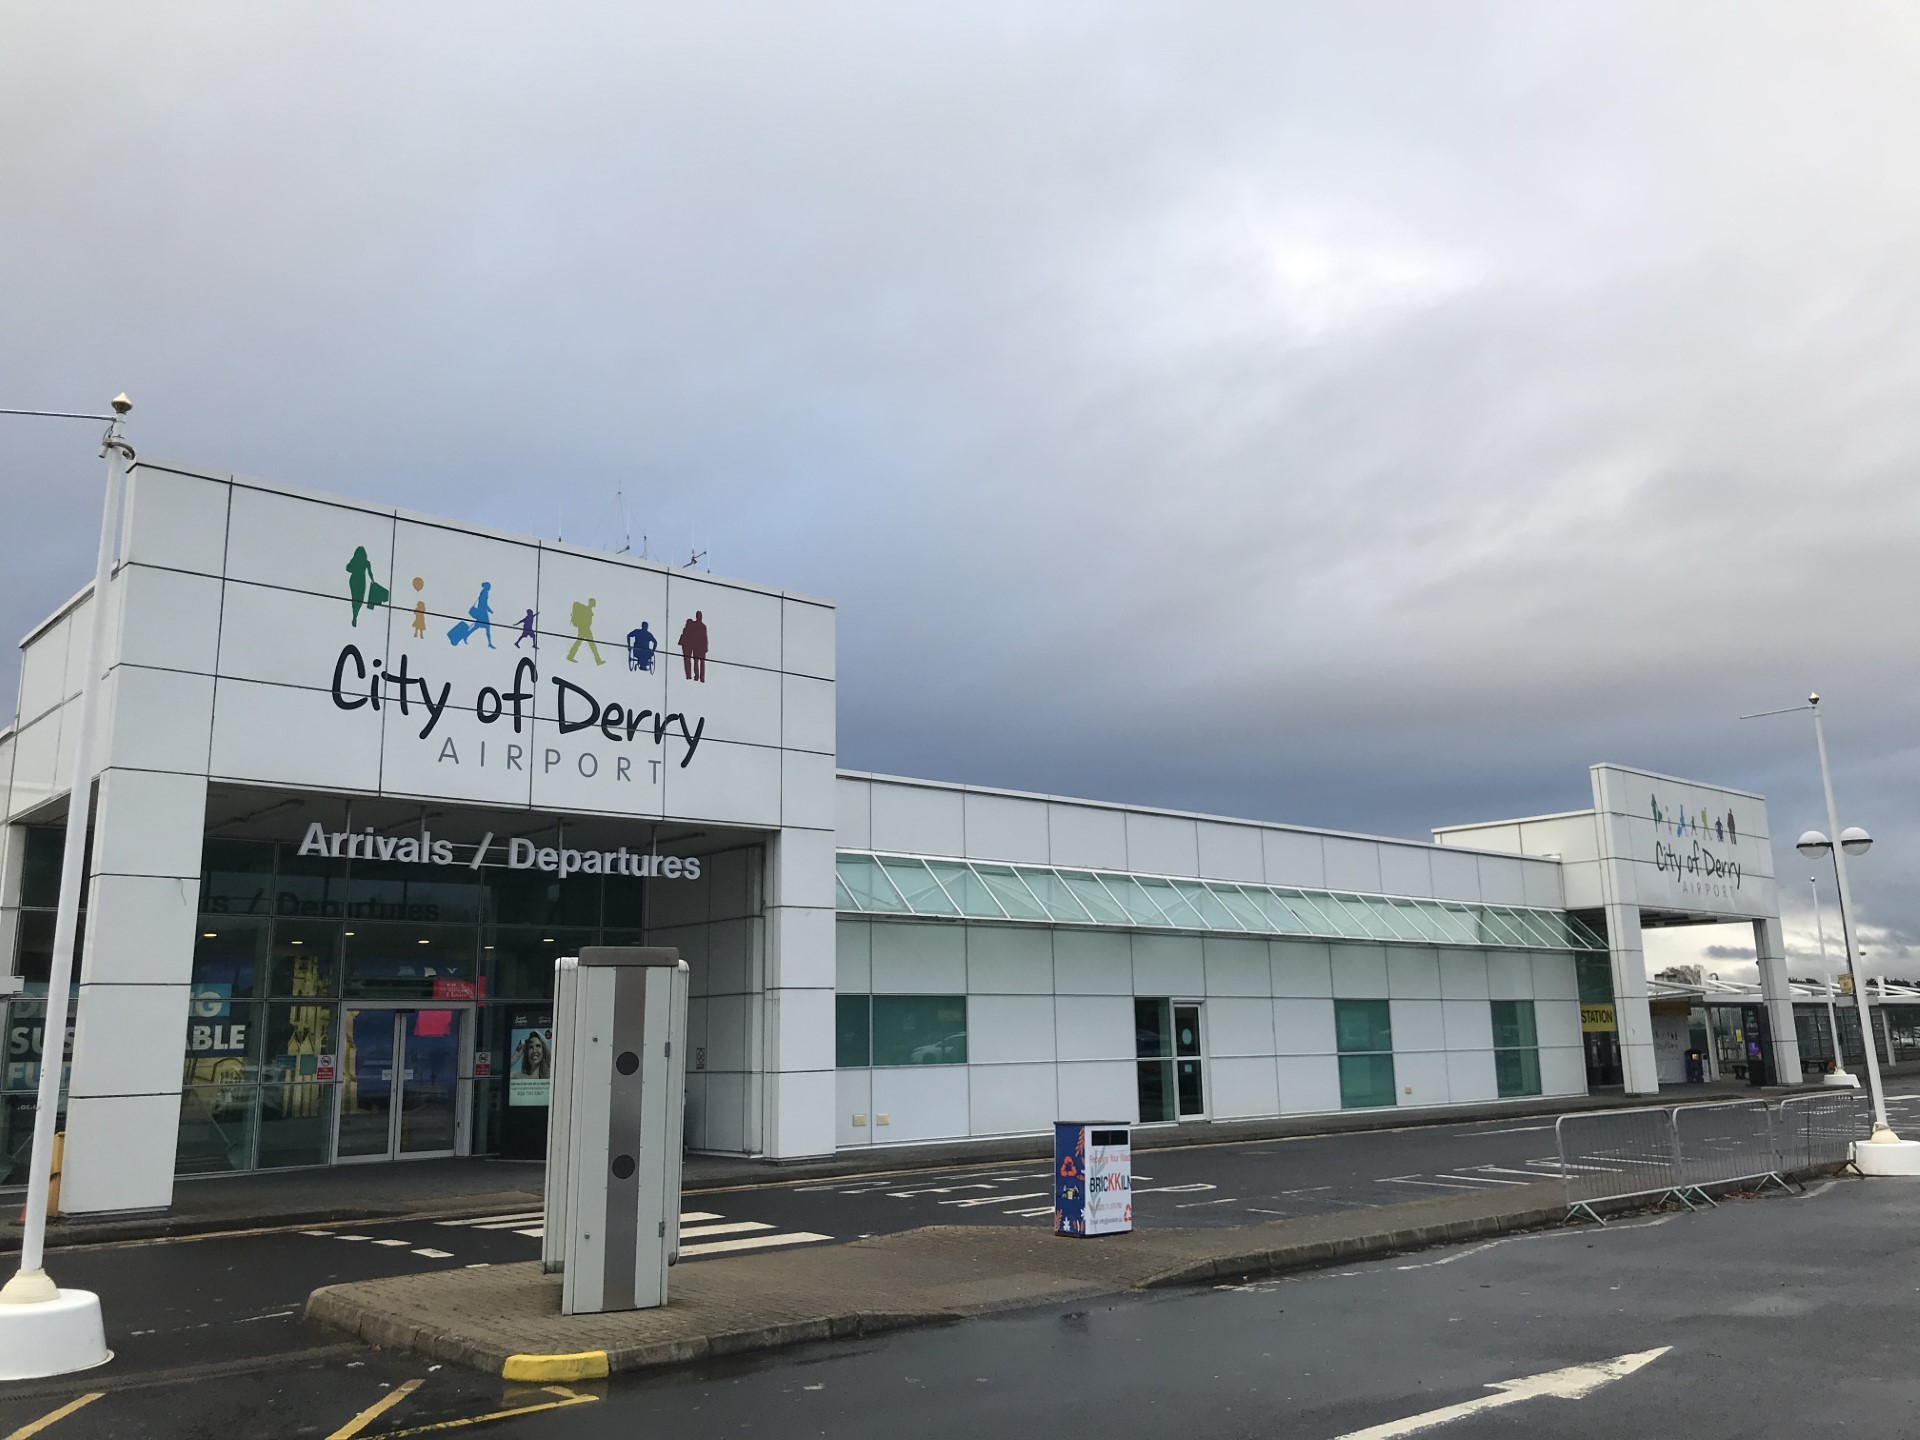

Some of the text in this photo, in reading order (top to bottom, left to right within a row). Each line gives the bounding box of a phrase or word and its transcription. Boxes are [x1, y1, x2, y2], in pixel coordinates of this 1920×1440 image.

[332, 644, 705, 769] City of Derry
[438, 736, 662, 785] AIRPORT
[299, 821, 454, 867] Arrivals
[508, 836, 702, 880] Departures
[1655, 839, 1741, 890] City of Derry
[1682, 880, 1735, 898] AIRPORT
[1580, 1009, 1613, 1024] STATION
